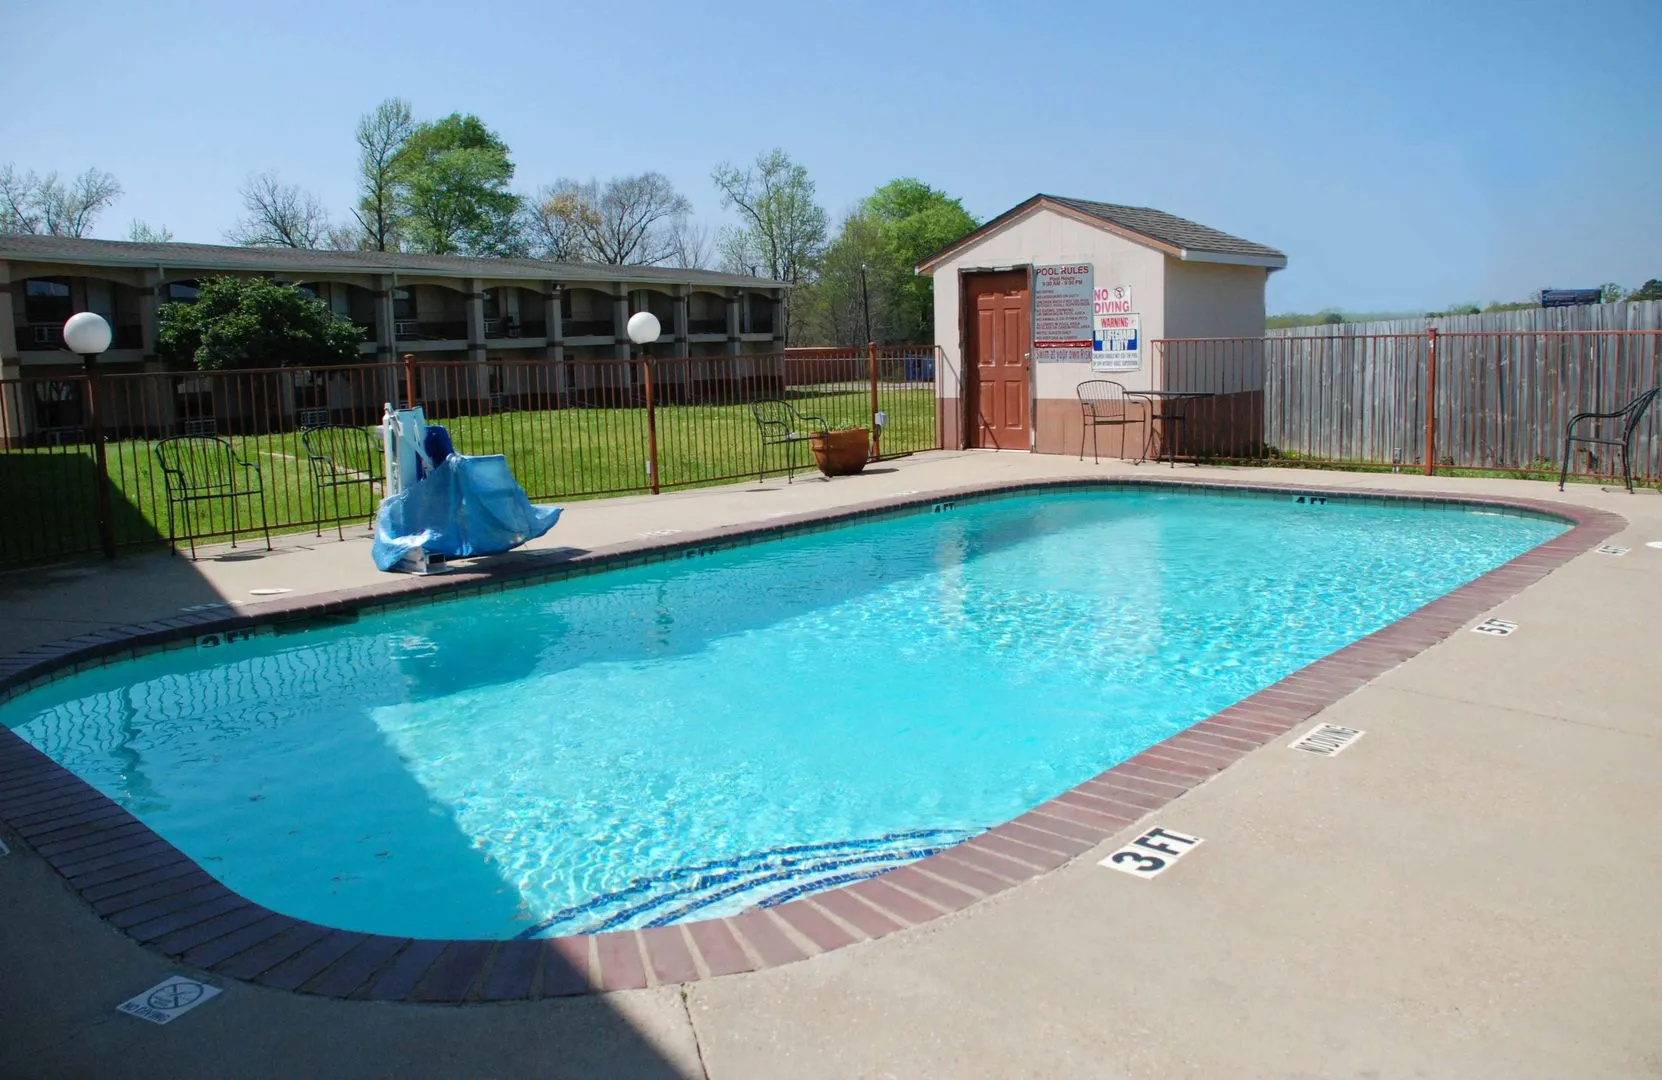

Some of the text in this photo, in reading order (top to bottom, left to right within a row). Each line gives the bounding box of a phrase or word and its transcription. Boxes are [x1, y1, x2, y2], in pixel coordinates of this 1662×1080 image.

[1036, 265, 1089, 276] POOL RULES
[1094, 289, 1109, 301] NO
[1094, 301, 1129, 314] DIVING
[1101, 317, 1129, 328] WARNING
[1476, 618, 1519, 635] 5 FT
[1112, 851, 1166, 872] 3
[123, 1002, 171, 1022] NO DIVING
